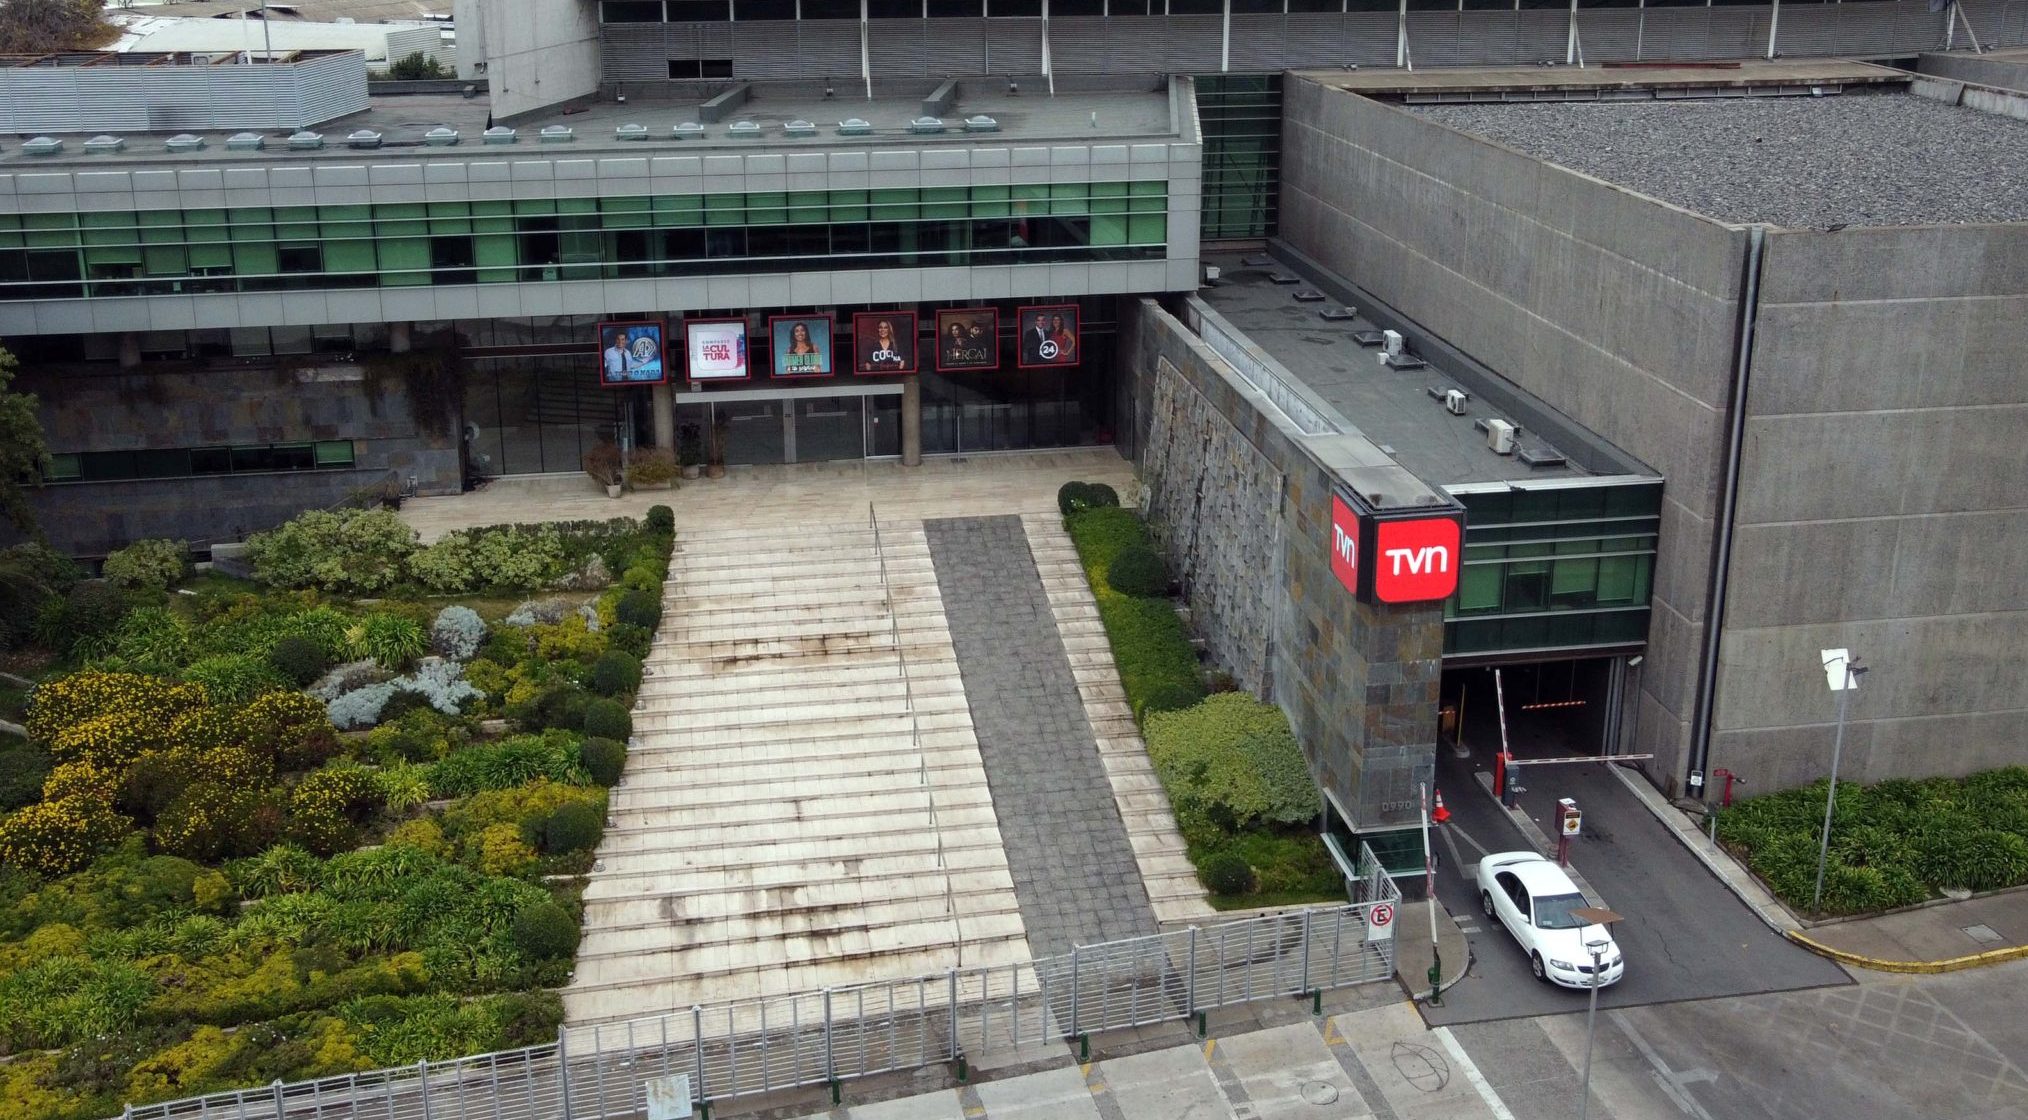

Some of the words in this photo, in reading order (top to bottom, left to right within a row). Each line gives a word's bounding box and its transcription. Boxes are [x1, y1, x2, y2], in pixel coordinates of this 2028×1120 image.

[1043, 345, 1054, 353] 24
[1382, 801, 1411, 811] 0990
[1376, 908, 1387, 922] E
